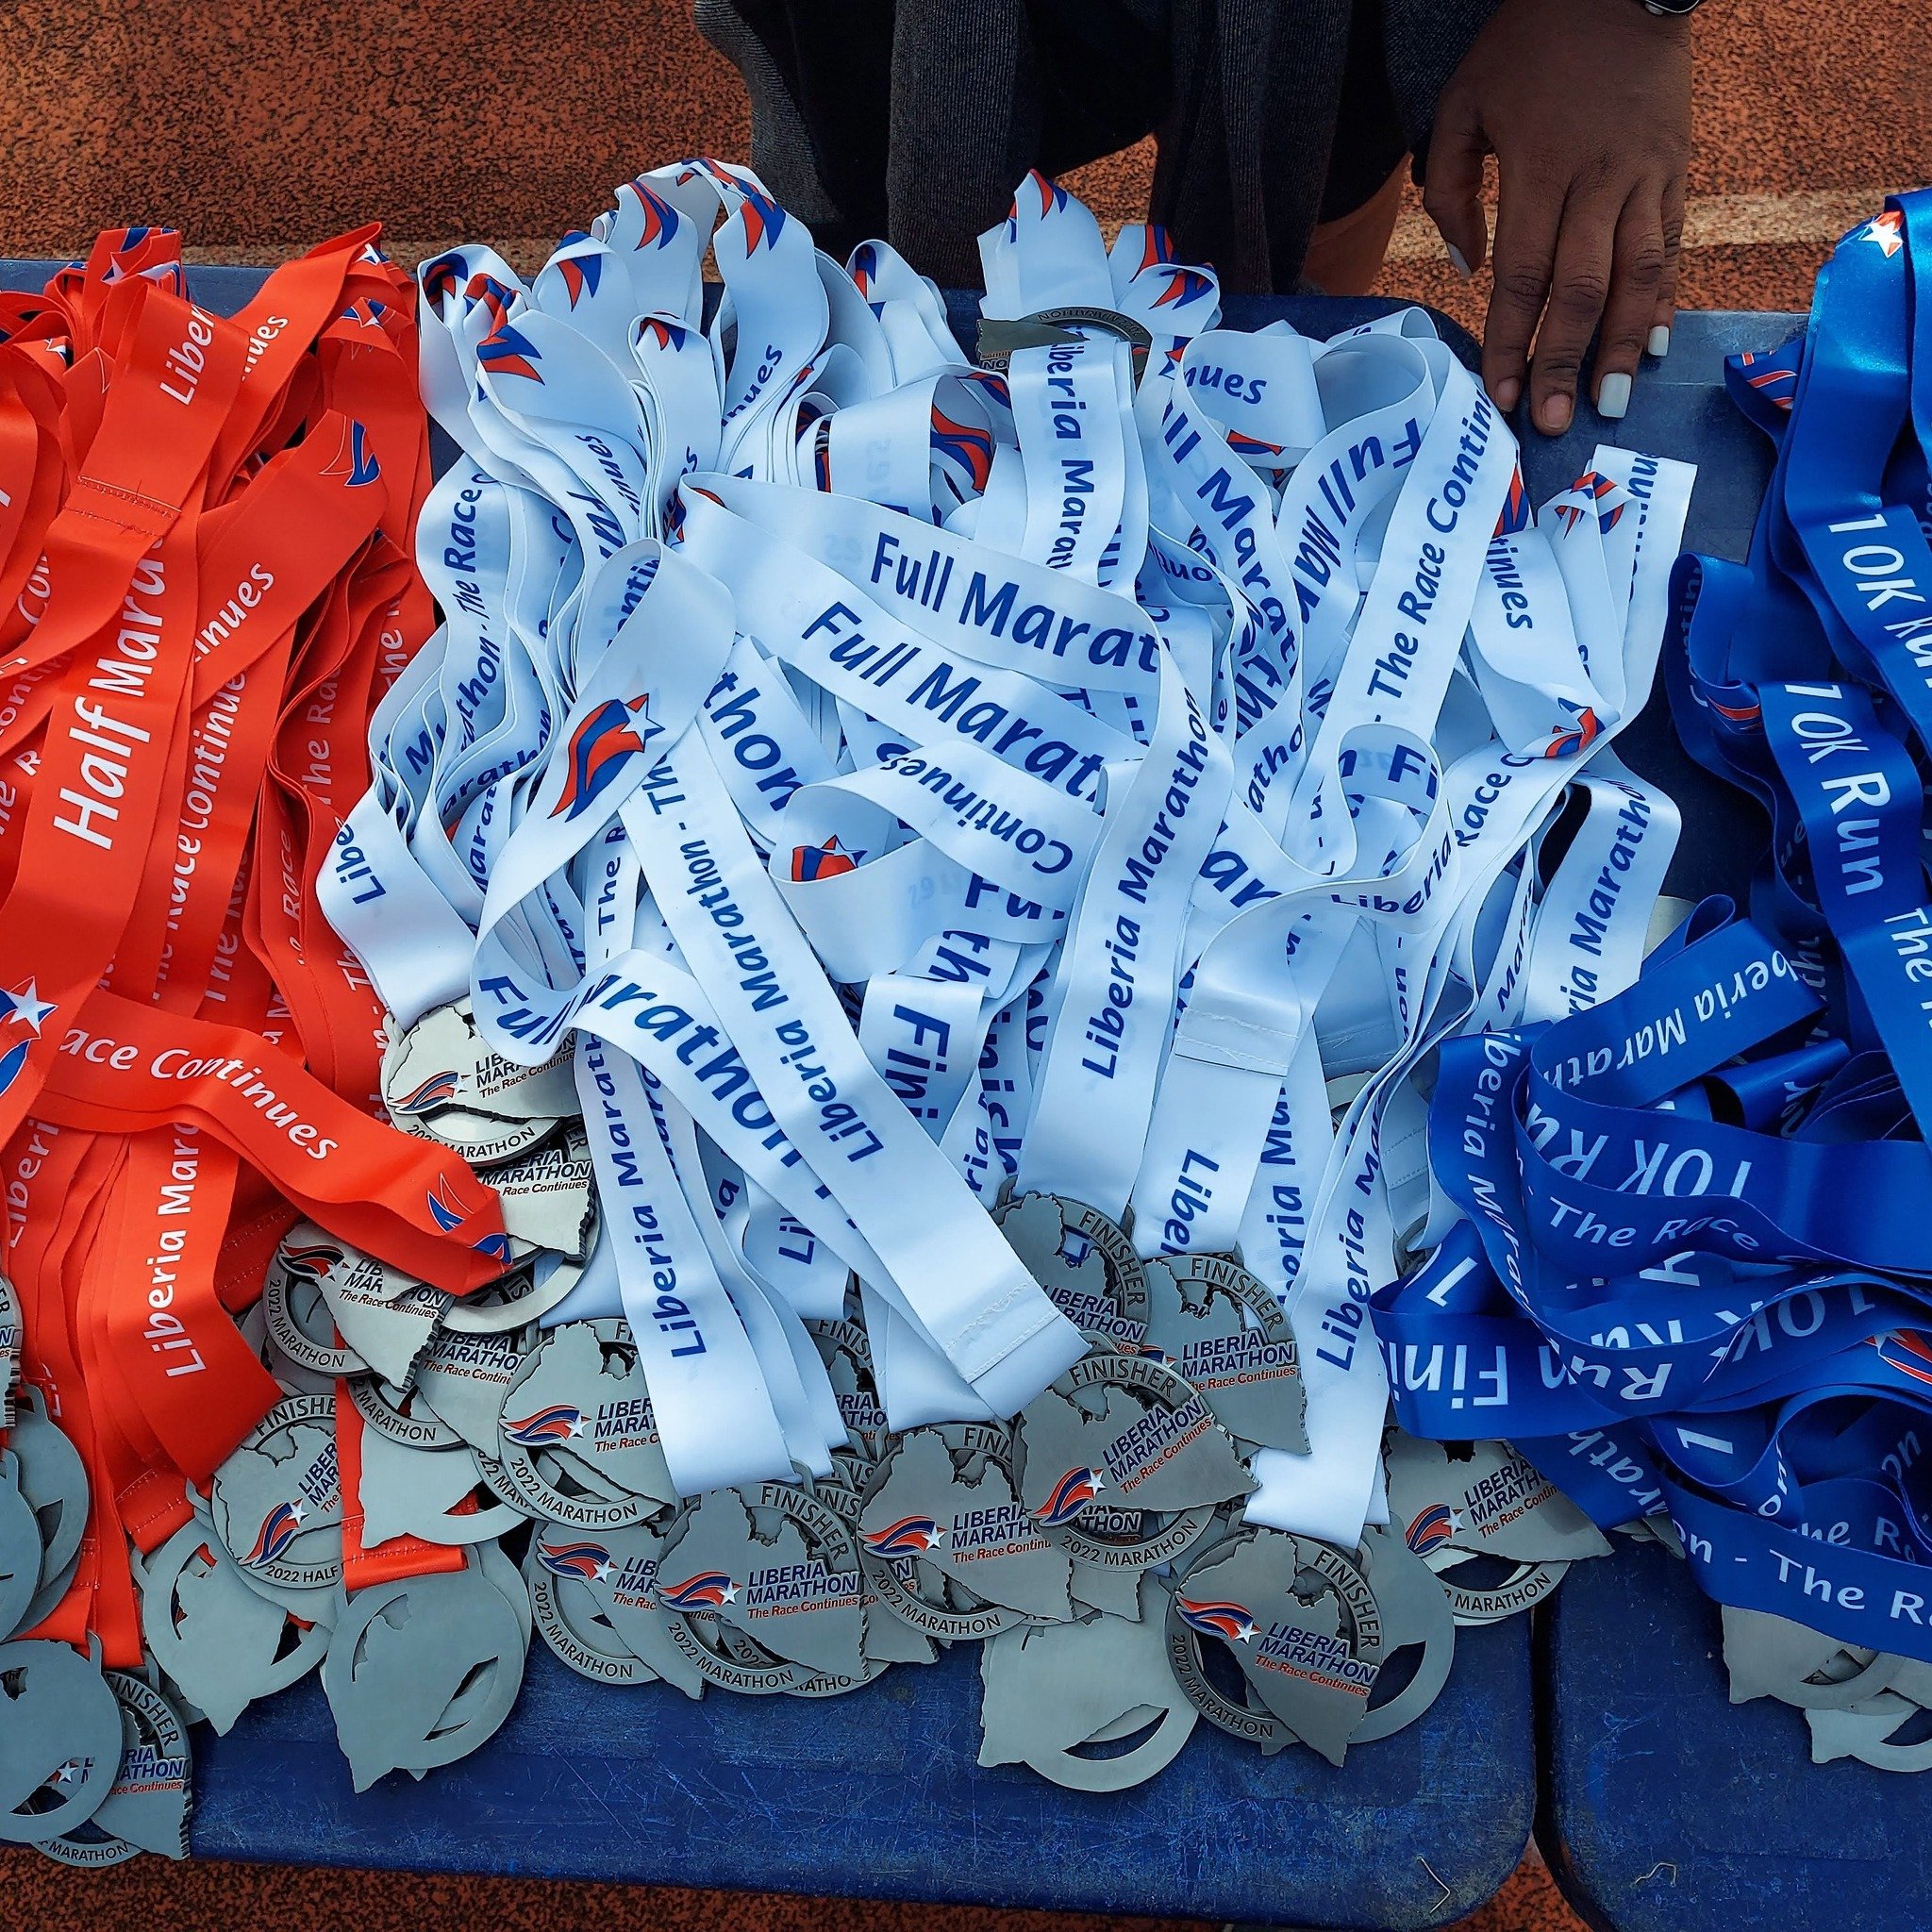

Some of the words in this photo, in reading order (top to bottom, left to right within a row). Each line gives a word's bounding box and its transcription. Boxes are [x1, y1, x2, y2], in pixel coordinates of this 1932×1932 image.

[159, 305, 215, 406] Liber
[1046, 342, 1087, 440] iberia
[1318, 418, 1422, 527] Full
[444, 488, 483, 573] Race
[1046, 459, 1094, 569] Marat
[1196, 467, 1297, 666] Marat
[1828, 513, 1926, 611] 10K
[88, 540, 167, 698] Mara
[453, 577, 490, 620] The
[871, 532, 954, 612] Full
[958, 572, 1161, 673] Marat
[1365, 628, 1418, 699] The
[1398, 541, 1444, 625] Race
[802, 601, 922, 688] Full
[906, 662, 1104, 800] Marat
[1785, 685, 1871, 764] 10K
[54, 695, 152, 850] Half
[704, 672, 804, 811] thon
[879, 757, 1074, 874] Continues
[1822, 772, 1890, 895] Run
[335, 824, 387, 906] Libe
[598, 857, 621, 936] The
[1331, 831, 1453, 914] Liberia
[679, 840, 790, 1013] Marathon
[1083, 915, 1141, 1079] Liberia
[1694, 949, 1801, 1020] beria
[479, 1085, 499, 1099] The
[502, 1073, 527, 1091] Race
[528, 1052, 575, 1077] Continue
[1544, 1008, 1688, 1089] Marath
[151, 1048, 339, 1161] Continues
[584, 1034, 644, 1187] Marath
[775, 1020, 884, 1162] Liberia
[1464, 1031, 1522, 1158] iberia
[8, 1119, 59, 1248] Liberi
[482, 1161, 591, 1185] MARATHON
[503, 1183, 529, 1196] Race
[531, 1179, 587, 1194] Continues
[1549, 1197, 1636, 1247] The
[1652, 1217, 1759, 1250] Race
[635, 1206, 707, 1357] Liberia
[1079, 1211, 1146, 1307] FINISHER
[1316, 1208, 1371, 1372] Liberia
[143, 1231, 207, 1378] Liberia
[268, 1279, 281, 1317] 2022
[339, 1289, 359, 1304] The
[360, 1293, 384, 1308] Race
[384, 1298, 437, 1320] Continues
[1191, 1258, 1284, 1332] FINISHER
[274, 1319, 345, 1368] MARATHON
[425, 1359, 441, 1374] The
[443, 1363, 471, 1377] Race
[430, 1342, 520, 1374] MARATHO
[1181, 1343, 1294, 1377] MARATHON
[1183, 1331, 1259, 1360] LIBERIA
[1390, 1344, 1508, 1408] Fini
[1070, 1358, 1176, 1399] FINISHER
[1208, 1375, 1235, 1391] Race
[1238, 1367, 1296, 1385] Continues
[255, 1396, 337, 1437] FINISHE
[358, 1389, 437, 1441] MARATHON
[594, 1414, 658, 1438] MARAT
[595, 1440, 617, 1453] The
[619, 1436, 647, 1450] Race
[1103, 1405, 1168, 1466] LIBERIA
[1109, 1399, 1203, 1483] MARATHON
[298, 1442, 338, 1494] LIBER
[1121, 1475, 1141, 1494] The
[1141, 1457, 1164, 1479] Race
[1163, 1417, 1212, 1460] Continues
[321, 1493, 340, 1513] The
[510, 1457, 541, 1494] 2022
[538, 1493, 638, 1524] MARATHON
[761, 1485, 849, 1560] FINISHER
[1469, 1472, 1548, 1524] MARATH
[1478, 1521, 1499, 1540] The
[1500, 1507, 1525, 1527] Race
[1525, 1485, 1559, 1509] Contin
[265, 1566, 299, 1583] 2022
[303, 1566, 339, 1583] HALF
[749, 1561, 824, 1588] LIBERIA
[953, 1552, 974, 1564] The
[977, 1548, 1004, 1561] Race
[1060, 1535, 1100, 1562] 2022
[1105, 1519, 1198, 1566] MARATHON
[613, 1592, 633, 1607] The
[635, 1597, 657, 1610] Rac
[747, 1573, 858, 1605] MARATHON
[748, 1607, 769, 1621] The
[771, 1604, 799, 1617] Race
[801, 1596, 858, 1613] Continues
[873, 1570, 903, 1607] 2022
[901, 1604, 1000, 1636] MARATHON
[1313, 1549, 1380, 1650] FINISHER
[1453, 1573, 1551, 1612] MARATHON
[1769, 1549, 1865, 1609] The
[534, 1582, 553, 1624] 2022
[546, 1624, 633, 1678] MARATHON
[668, 1622, 699, 1660] 2022
[695, 1657, 795, 1690] MARATHON
[1258, 1636, 1380, 1684] MARATHON
[1267, 1622, 1351, 1658] LIBERIA
[1171, 1634, 1191, 1676] 2022
[1184, 1677, 1274, 1738] MARATHON
[1256, 1655, 1277, 1673] The
[1279, 1660, 1308, 1680] Race
[1309, 1669, 1370, 1698] Continues
[116, 1761, 184, 1780] ATHON
[129, 1780, 182, 1794] Continues
[48, 1840, 130, 1862] MARATHON
